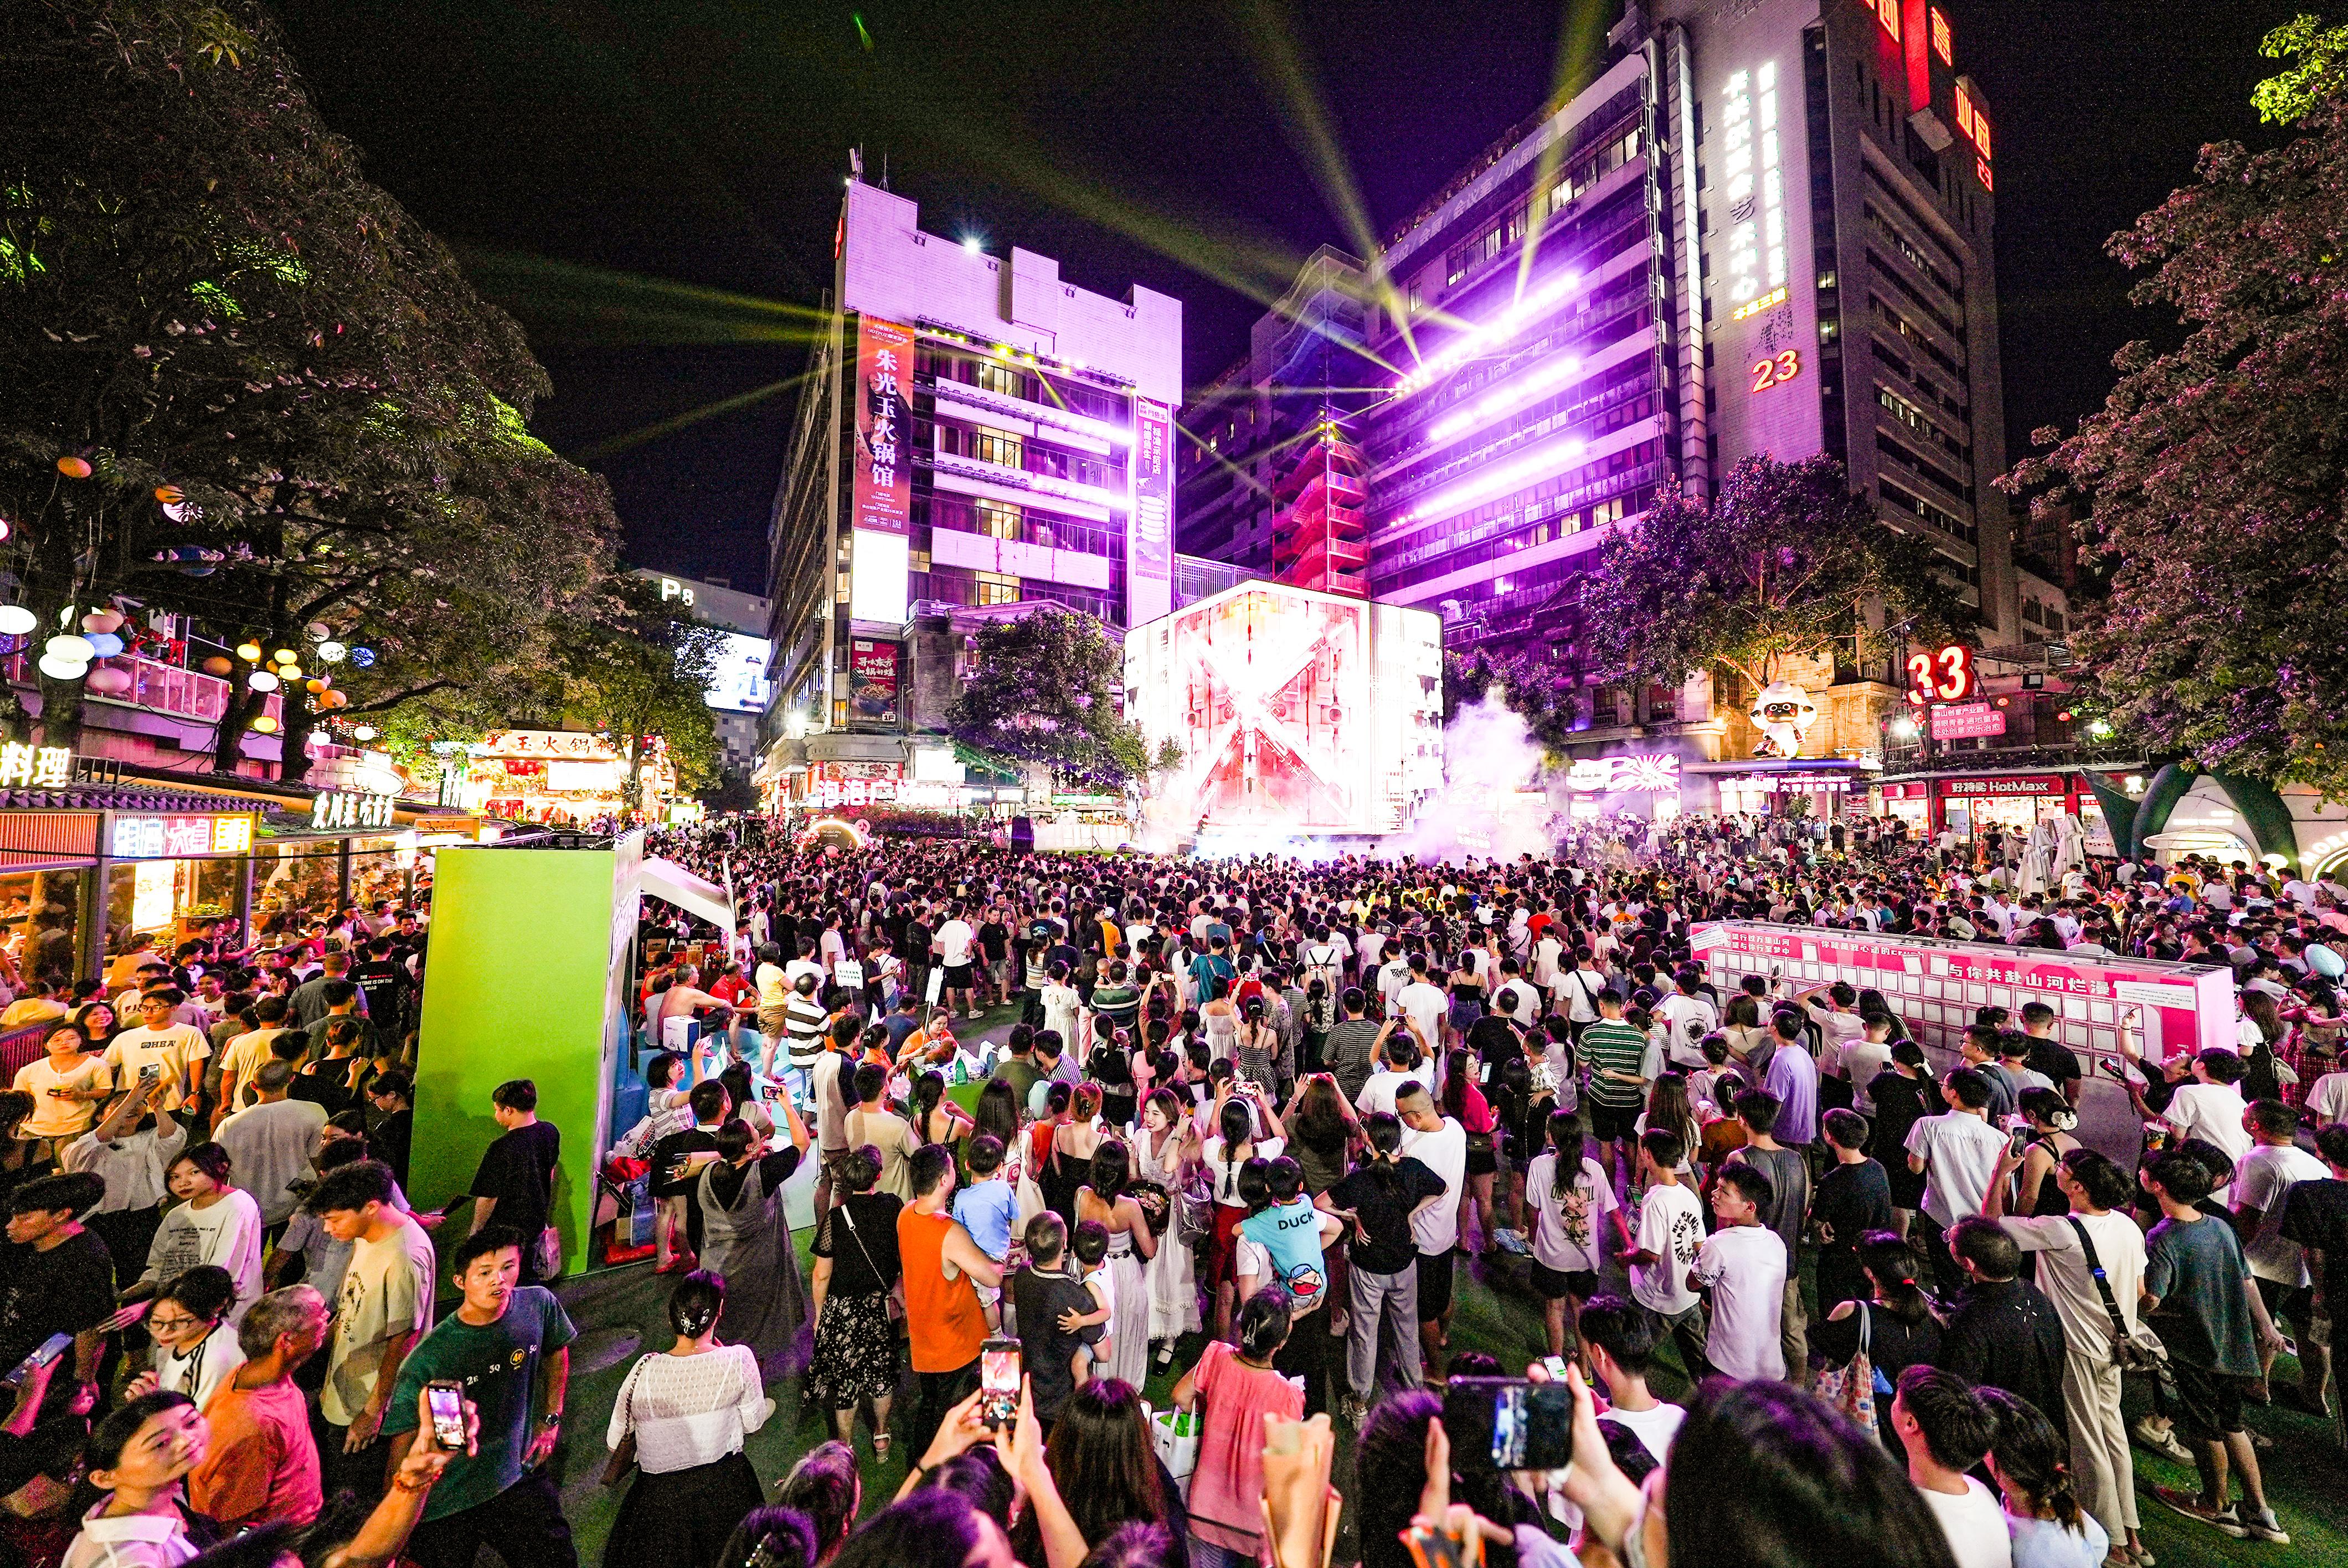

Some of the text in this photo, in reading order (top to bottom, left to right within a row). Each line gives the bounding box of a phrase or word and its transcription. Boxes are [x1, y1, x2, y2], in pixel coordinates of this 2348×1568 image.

[1754, 349, 1798, 391] 23
[872, 349, 897, 487] 朱光玉火锅馆
[1908, 646, 1966, 705] 33
[1933, 706, 1984, 718] 佛山创意产业园
[0, 741, 71, 787] 料理
[1948, 963, 2110, 996] 与你共赴山河烂漫
[1278, 1210, 1315, 1230] DUCK
